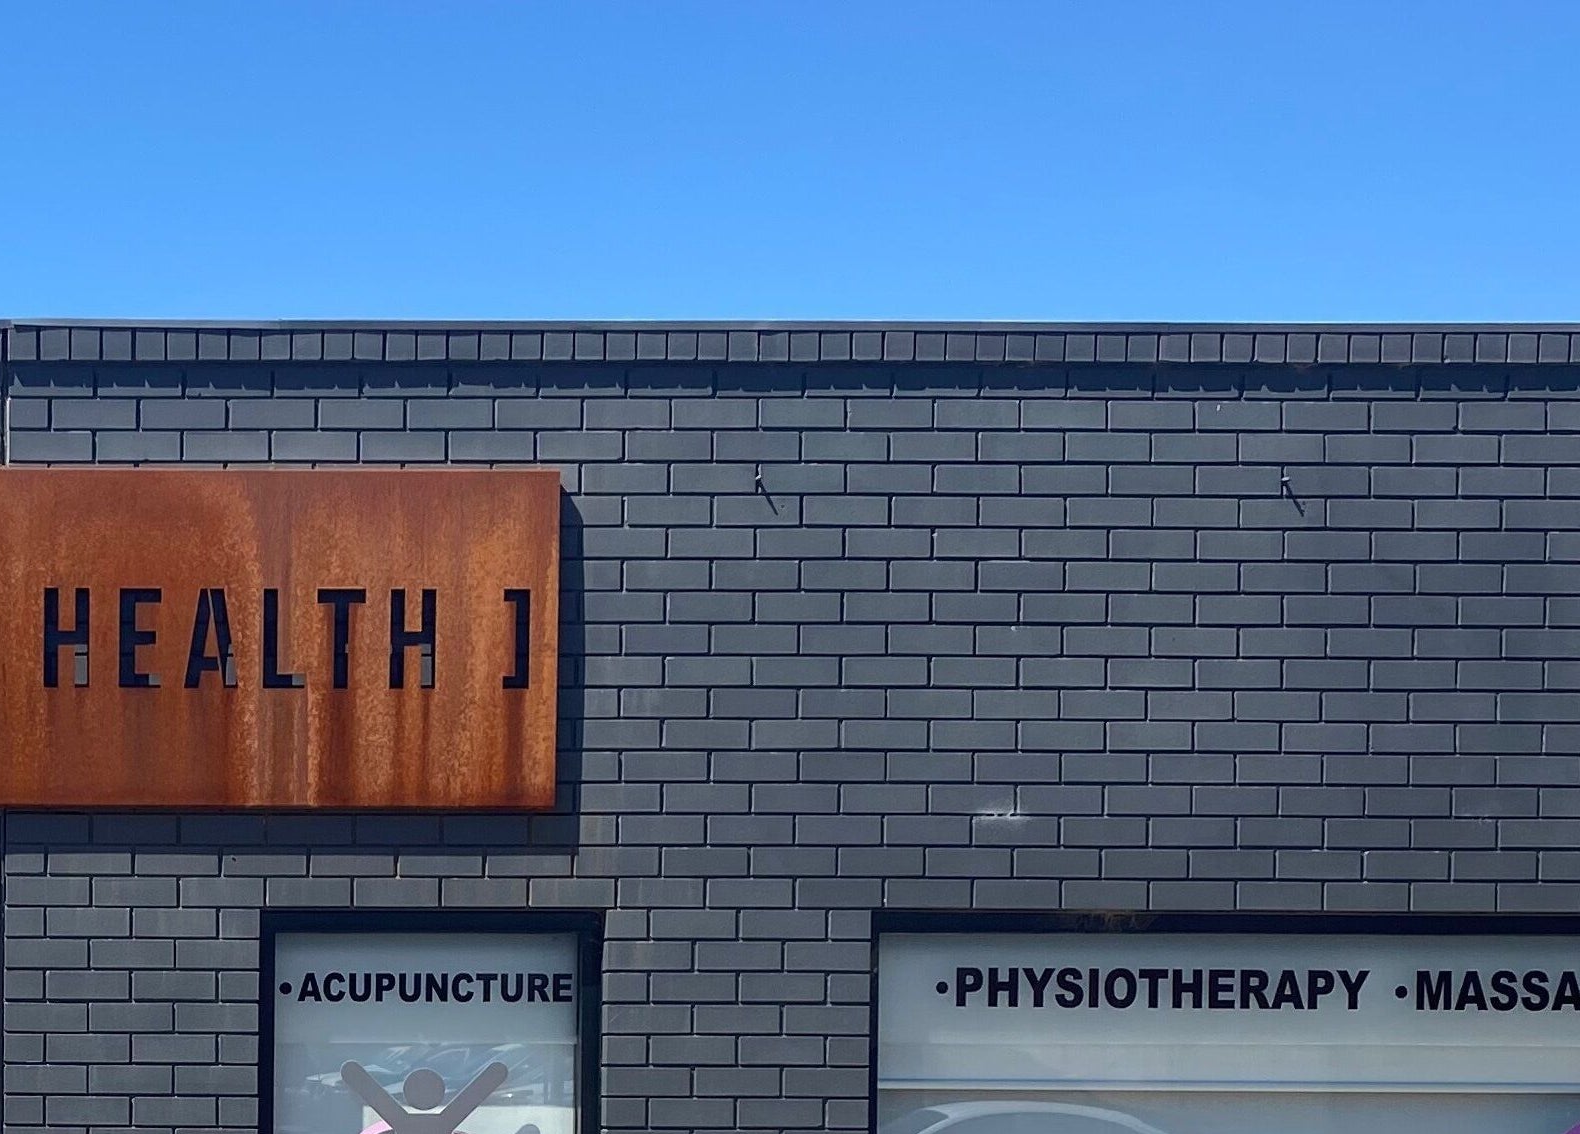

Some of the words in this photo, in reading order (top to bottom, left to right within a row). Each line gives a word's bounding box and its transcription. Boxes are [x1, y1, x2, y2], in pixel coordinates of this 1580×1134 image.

[42, 587, 438, 691] HEALTH
[297, 972, 574, 1003] ACUPUNCTURE
[955, 966, 1371, 1010] PHYSIOTHERAPY
[1415, 970, 1580, 1012] MASSA
